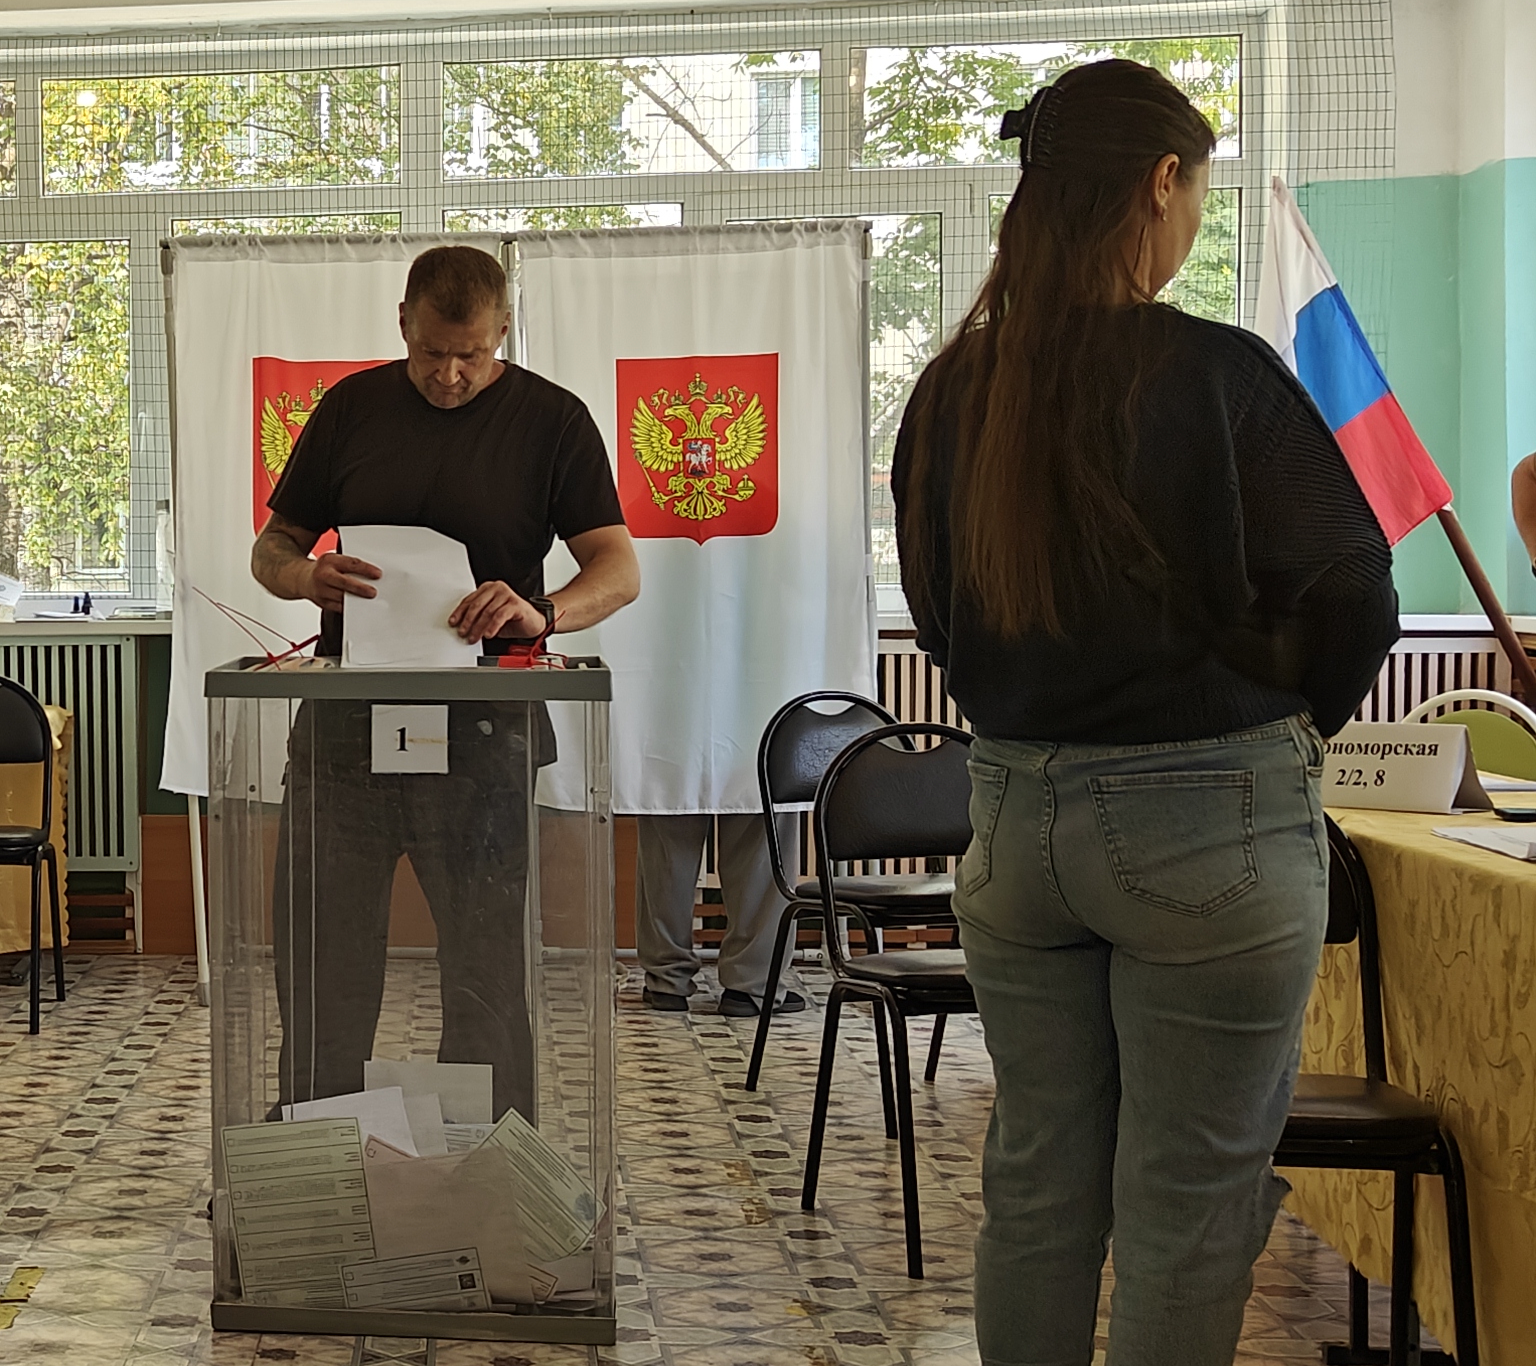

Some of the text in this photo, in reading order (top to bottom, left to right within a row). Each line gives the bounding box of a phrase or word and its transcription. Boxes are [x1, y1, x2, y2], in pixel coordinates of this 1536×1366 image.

[396, 726, 409, 752] 1
[1335, 768, 1386, 790] 2/2, 8
